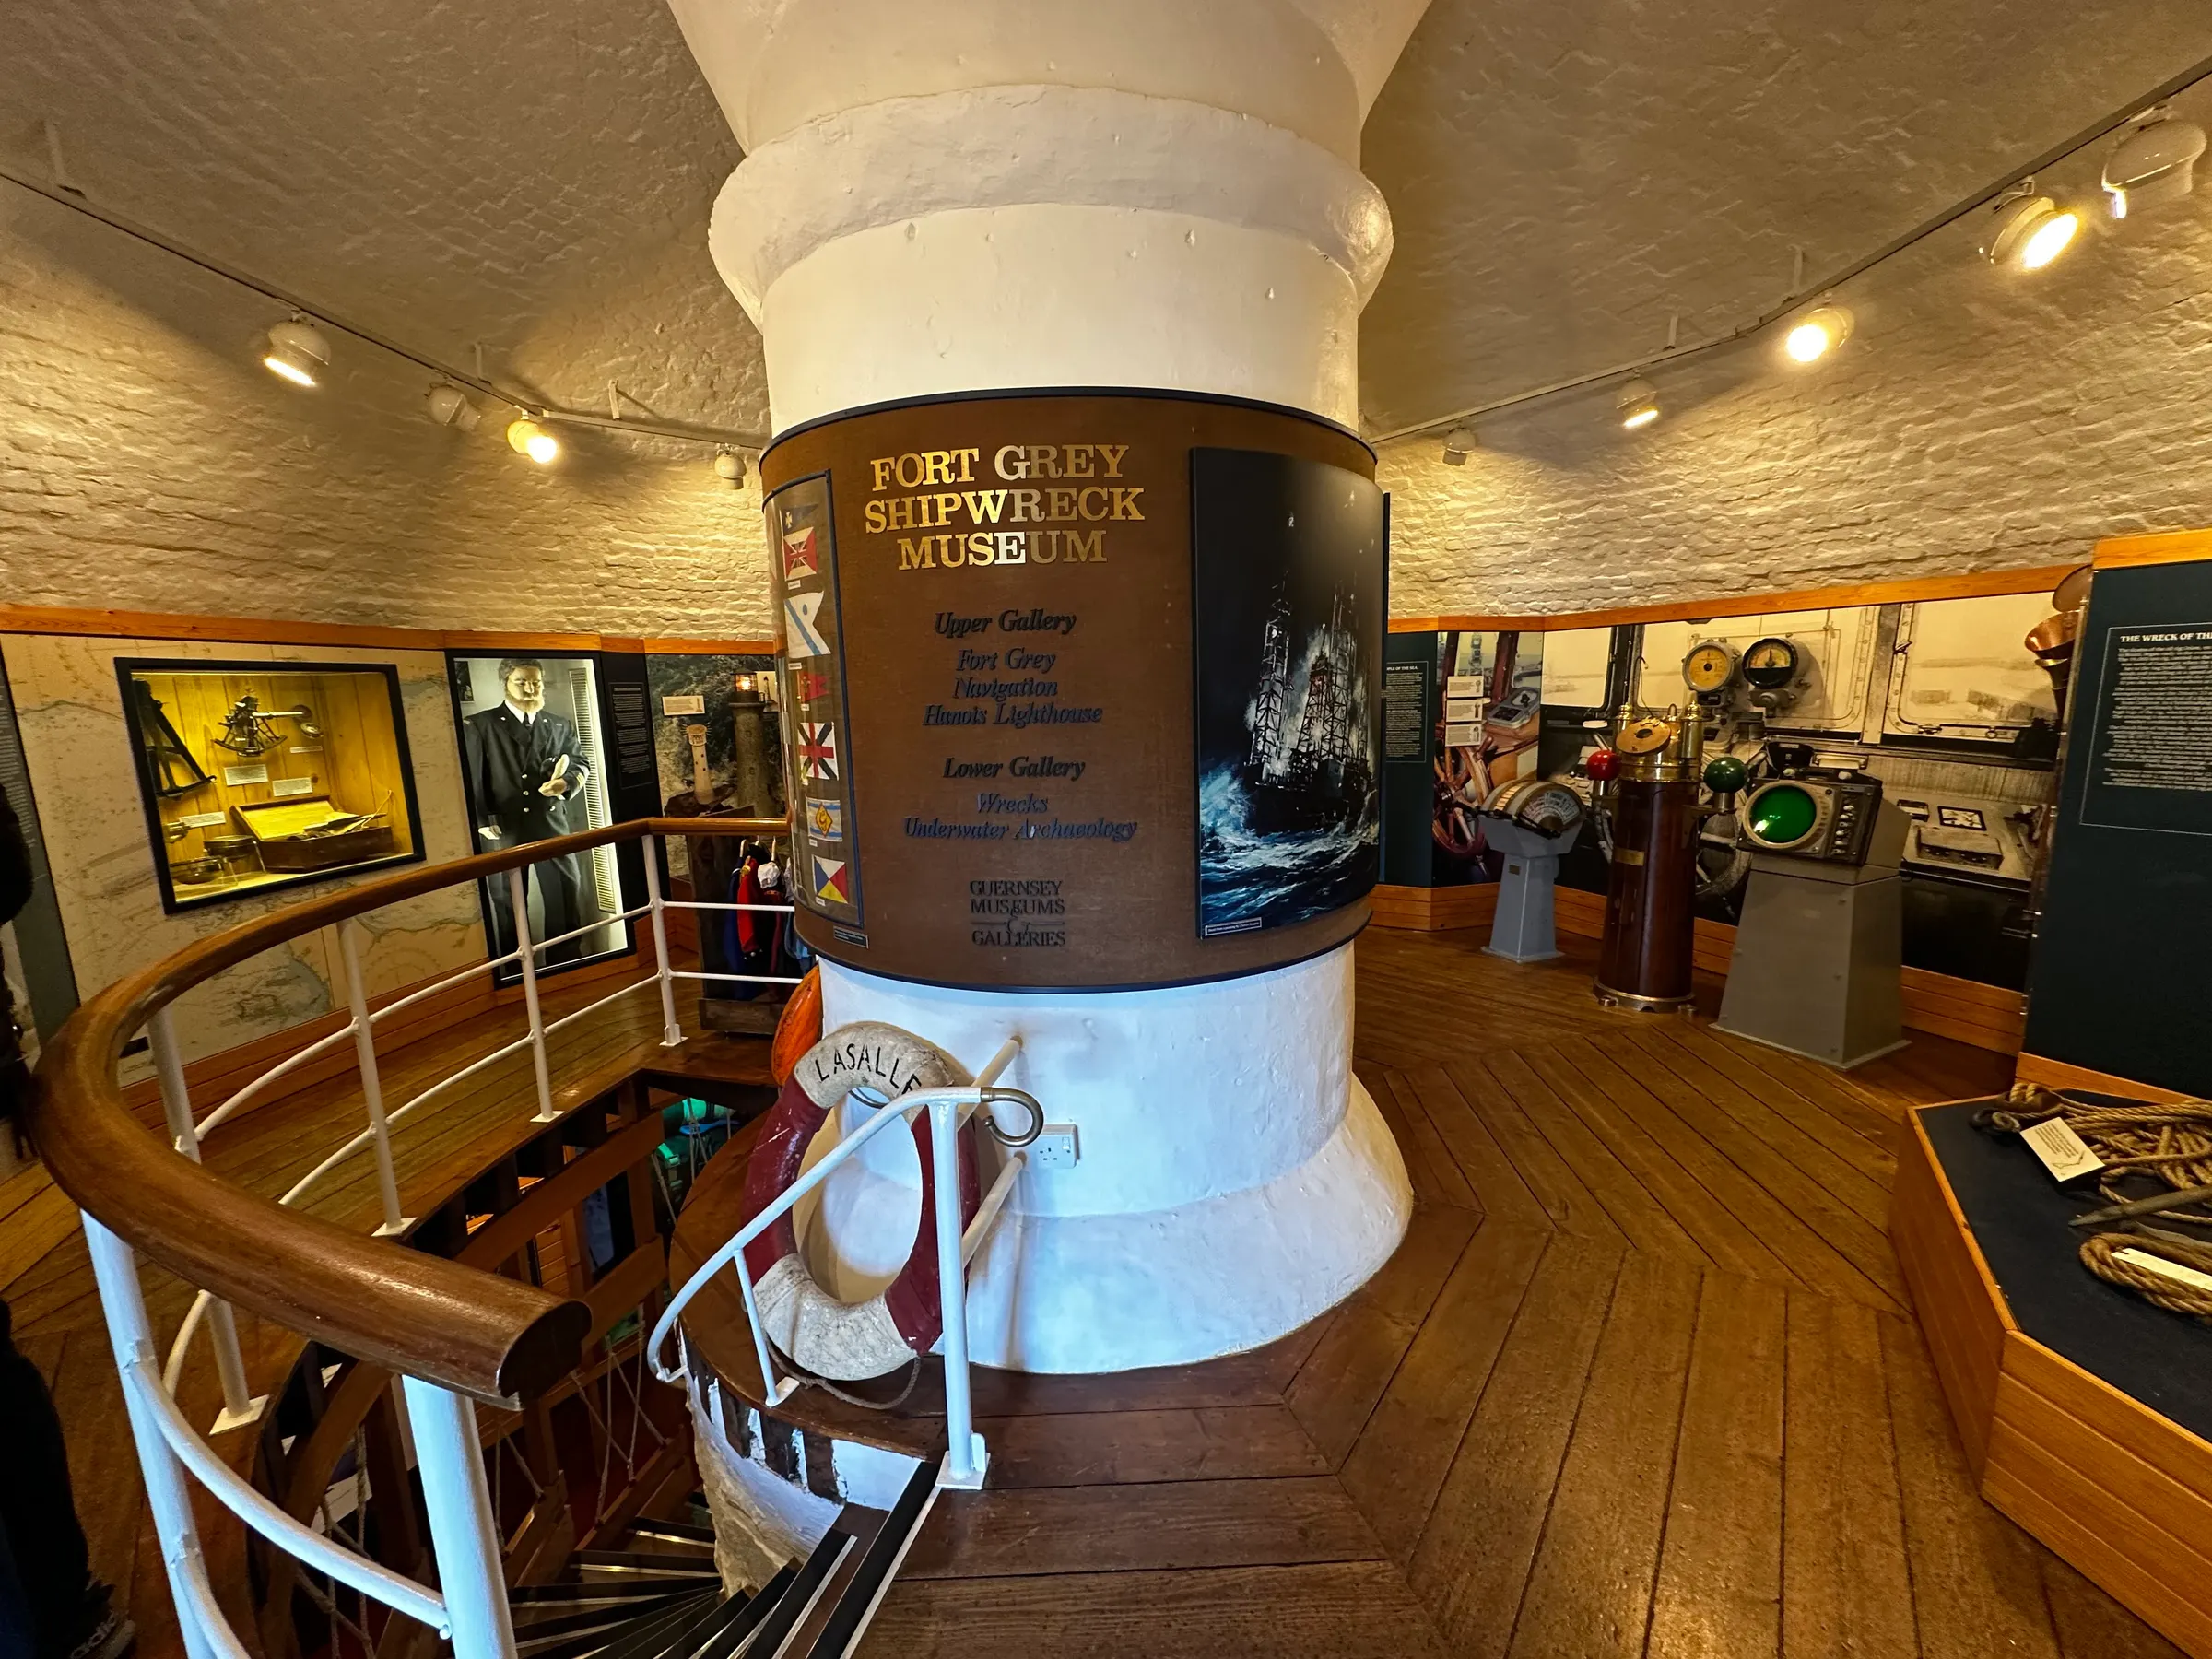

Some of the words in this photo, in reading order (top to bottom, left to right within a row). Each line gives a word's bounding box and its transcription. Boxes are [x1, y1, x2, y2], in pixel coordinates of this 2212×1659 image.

[870, 448, 980, 491] FORT
[994, 444, 1130, 480] GREY
[865, 488, 1146, 533] SHIPWRECK
[897, 530, 1108, 571] MUSEUM
[935, 612, 993, 638] Upper
[998, 609, 1077, 634] Gallery
[2142, 633, 2177, 641] WRECK
[2180, 632, 2194, 641] OF
[956, 649, 998, 672] Fort
[1005, 647, 1056, 674] Grey
[953, 677, 1058, 702] Navigation
[923, 704, 987, 726] Hanois
[994, 702, 1103, 729] Lighthouse
[943, 757, 1004, 779] Lower
[1009, 756, 1086, 782] Gallery
[977, 793, 1049, 814] Wrecks
[903, 817, 1010, 840] Underwater
[1015, 818, 1138, 843] Archaeology
[970, 880, 1063, 897] GUERNSEY
[971, 899, 1065, 915] MUSEUMS
[971, 930, 1066, 947] GALLERIES
[815, 1042, 922, 1095] LASALLE
